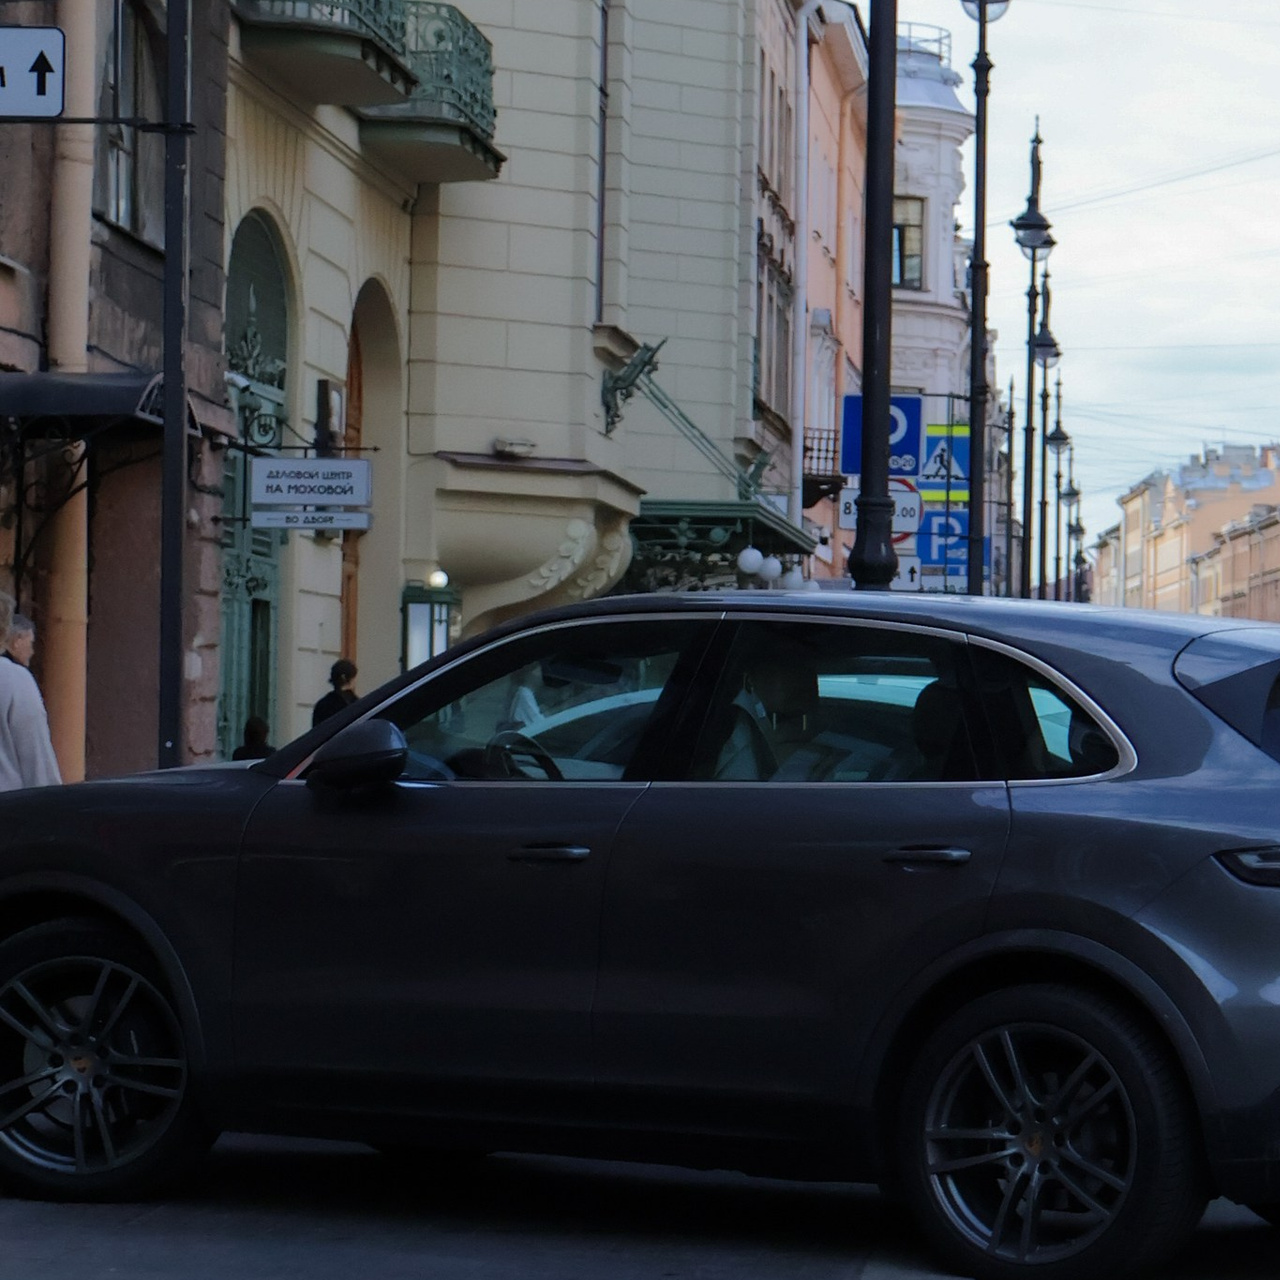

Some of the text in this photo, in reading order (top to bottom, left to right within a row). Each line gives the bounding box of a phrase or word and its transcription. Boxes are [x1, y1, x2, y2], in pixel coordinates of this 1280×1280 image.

[266, 470, 353, 480] ДЕЛОВОЙ ЦЕНТР
[265, 481, 354, 495] НА МОХОВОЙ
[285, 515, 334, 524] ВО ДВОРЕ
[931, 516, 962, 560] P
